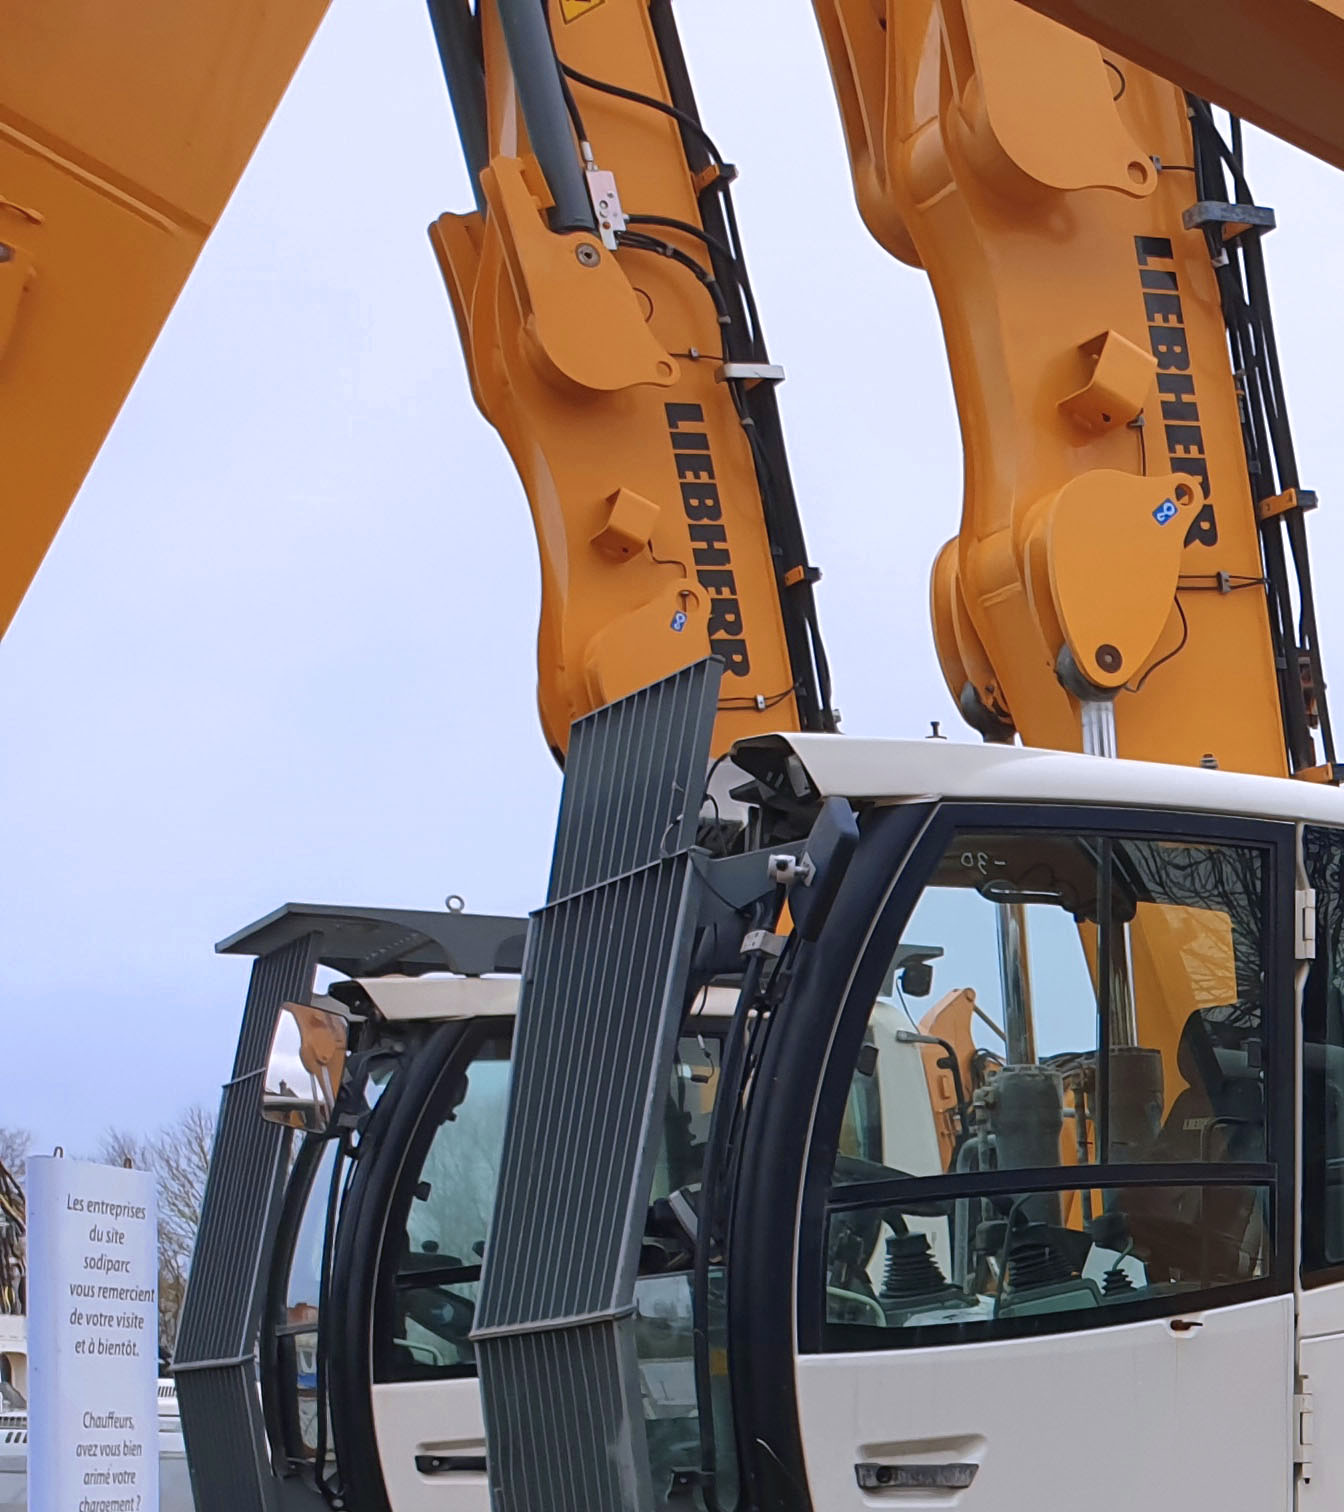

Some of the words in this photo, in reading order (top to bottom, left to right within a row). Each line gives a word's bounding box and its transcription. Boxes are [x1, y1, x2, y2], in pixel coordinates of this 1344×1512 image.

[664, 402, 751, 678] LIEBHERR
[67, 1193, 84, 1212] Les
[86, 1200, 146, 1221] entreprises
[89, 1223, 104, 1242] du
[105, 1227, 125, 1245] site
[83, 1253, 131, 1275] sodiparc
[69, 1283, 96, 1298] vous
[97, 1285, 155, 1303] remercient
[69, 1307, 84, 1326] de
[86, 1312, 114, 1328] votre
[116, 1312, 145, 1330] visite
[74, 1339, 86, 1354] et
[88, 1338, 95, 1354] à
[76, 1444, 98, 1457] avez
[99, 1444, 121, 1457] vous
[122, 1440, 143, 1457] bien
[112, 1470, 136, 1484] votre
